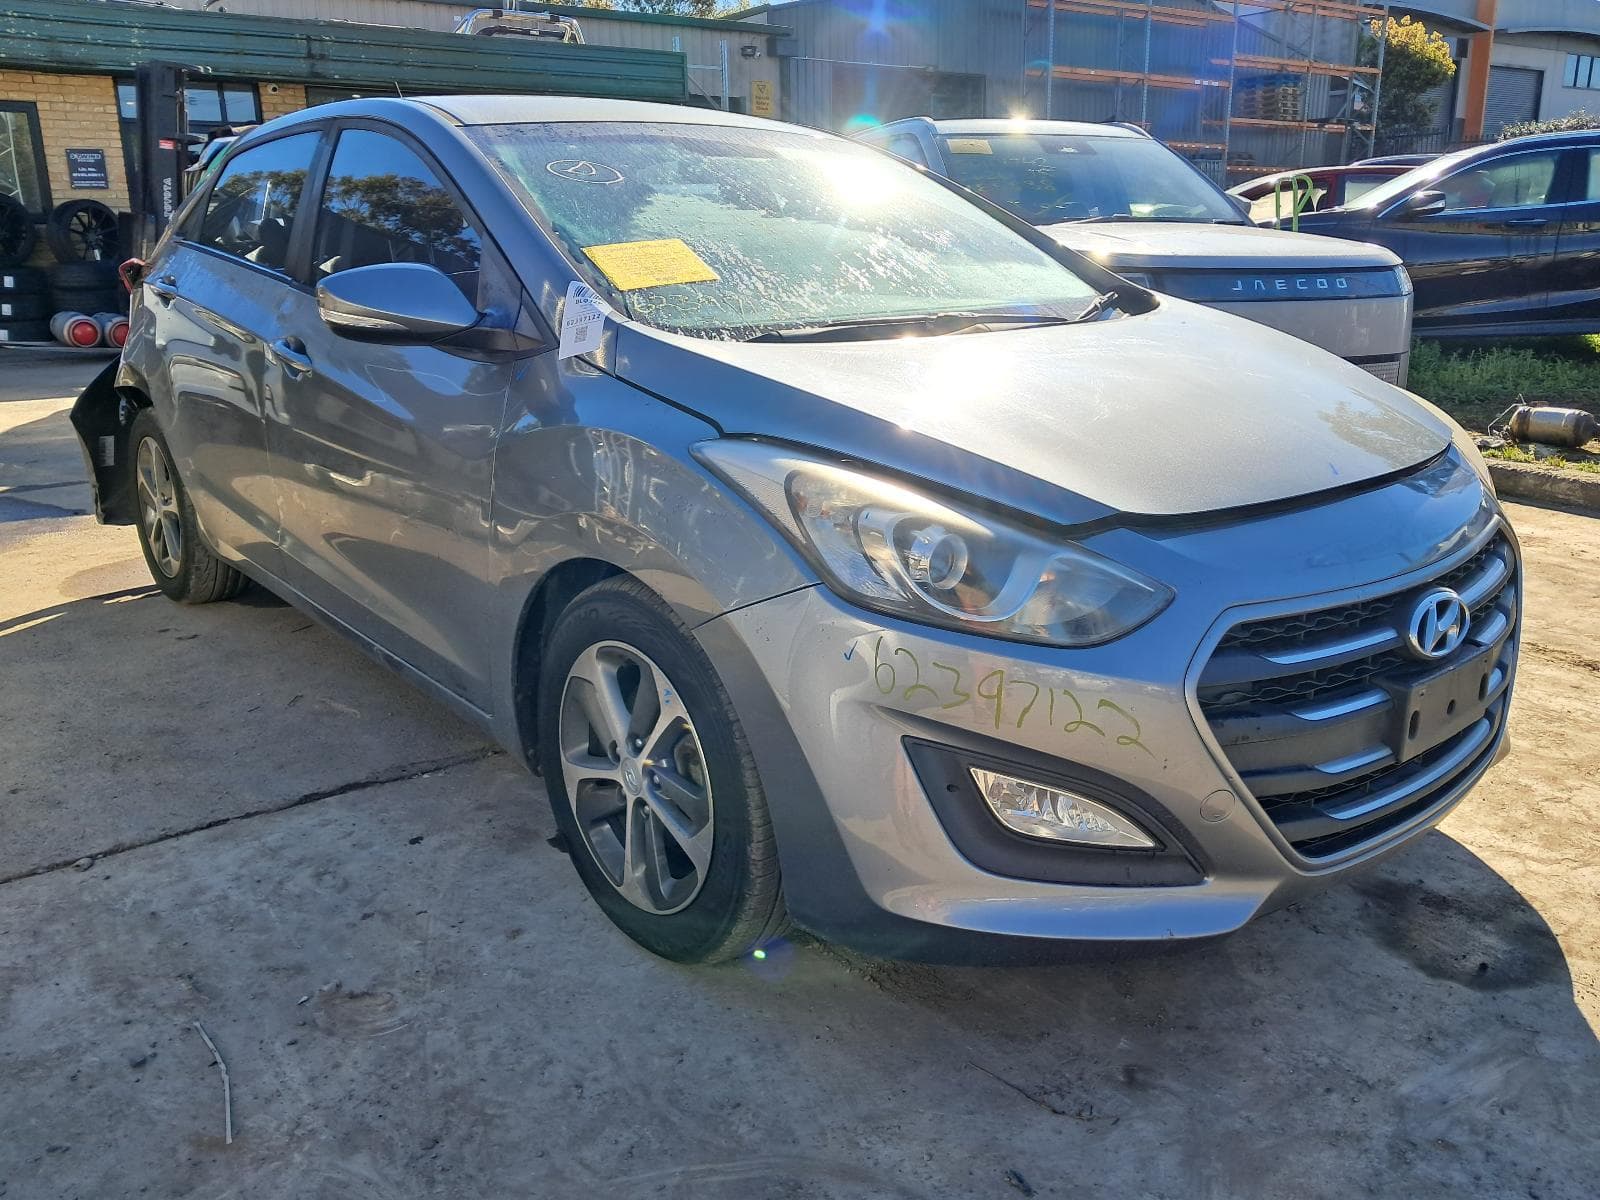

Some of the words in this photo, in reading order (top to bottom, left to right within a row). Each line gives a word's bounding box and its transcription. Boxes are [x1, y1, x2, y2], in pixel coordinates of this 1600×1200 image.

[163, 177, 173, 218] TOYOTA
[1231, 277, 1349, 291] JAECOO
[873, 636, 1157, 759] 62397122
